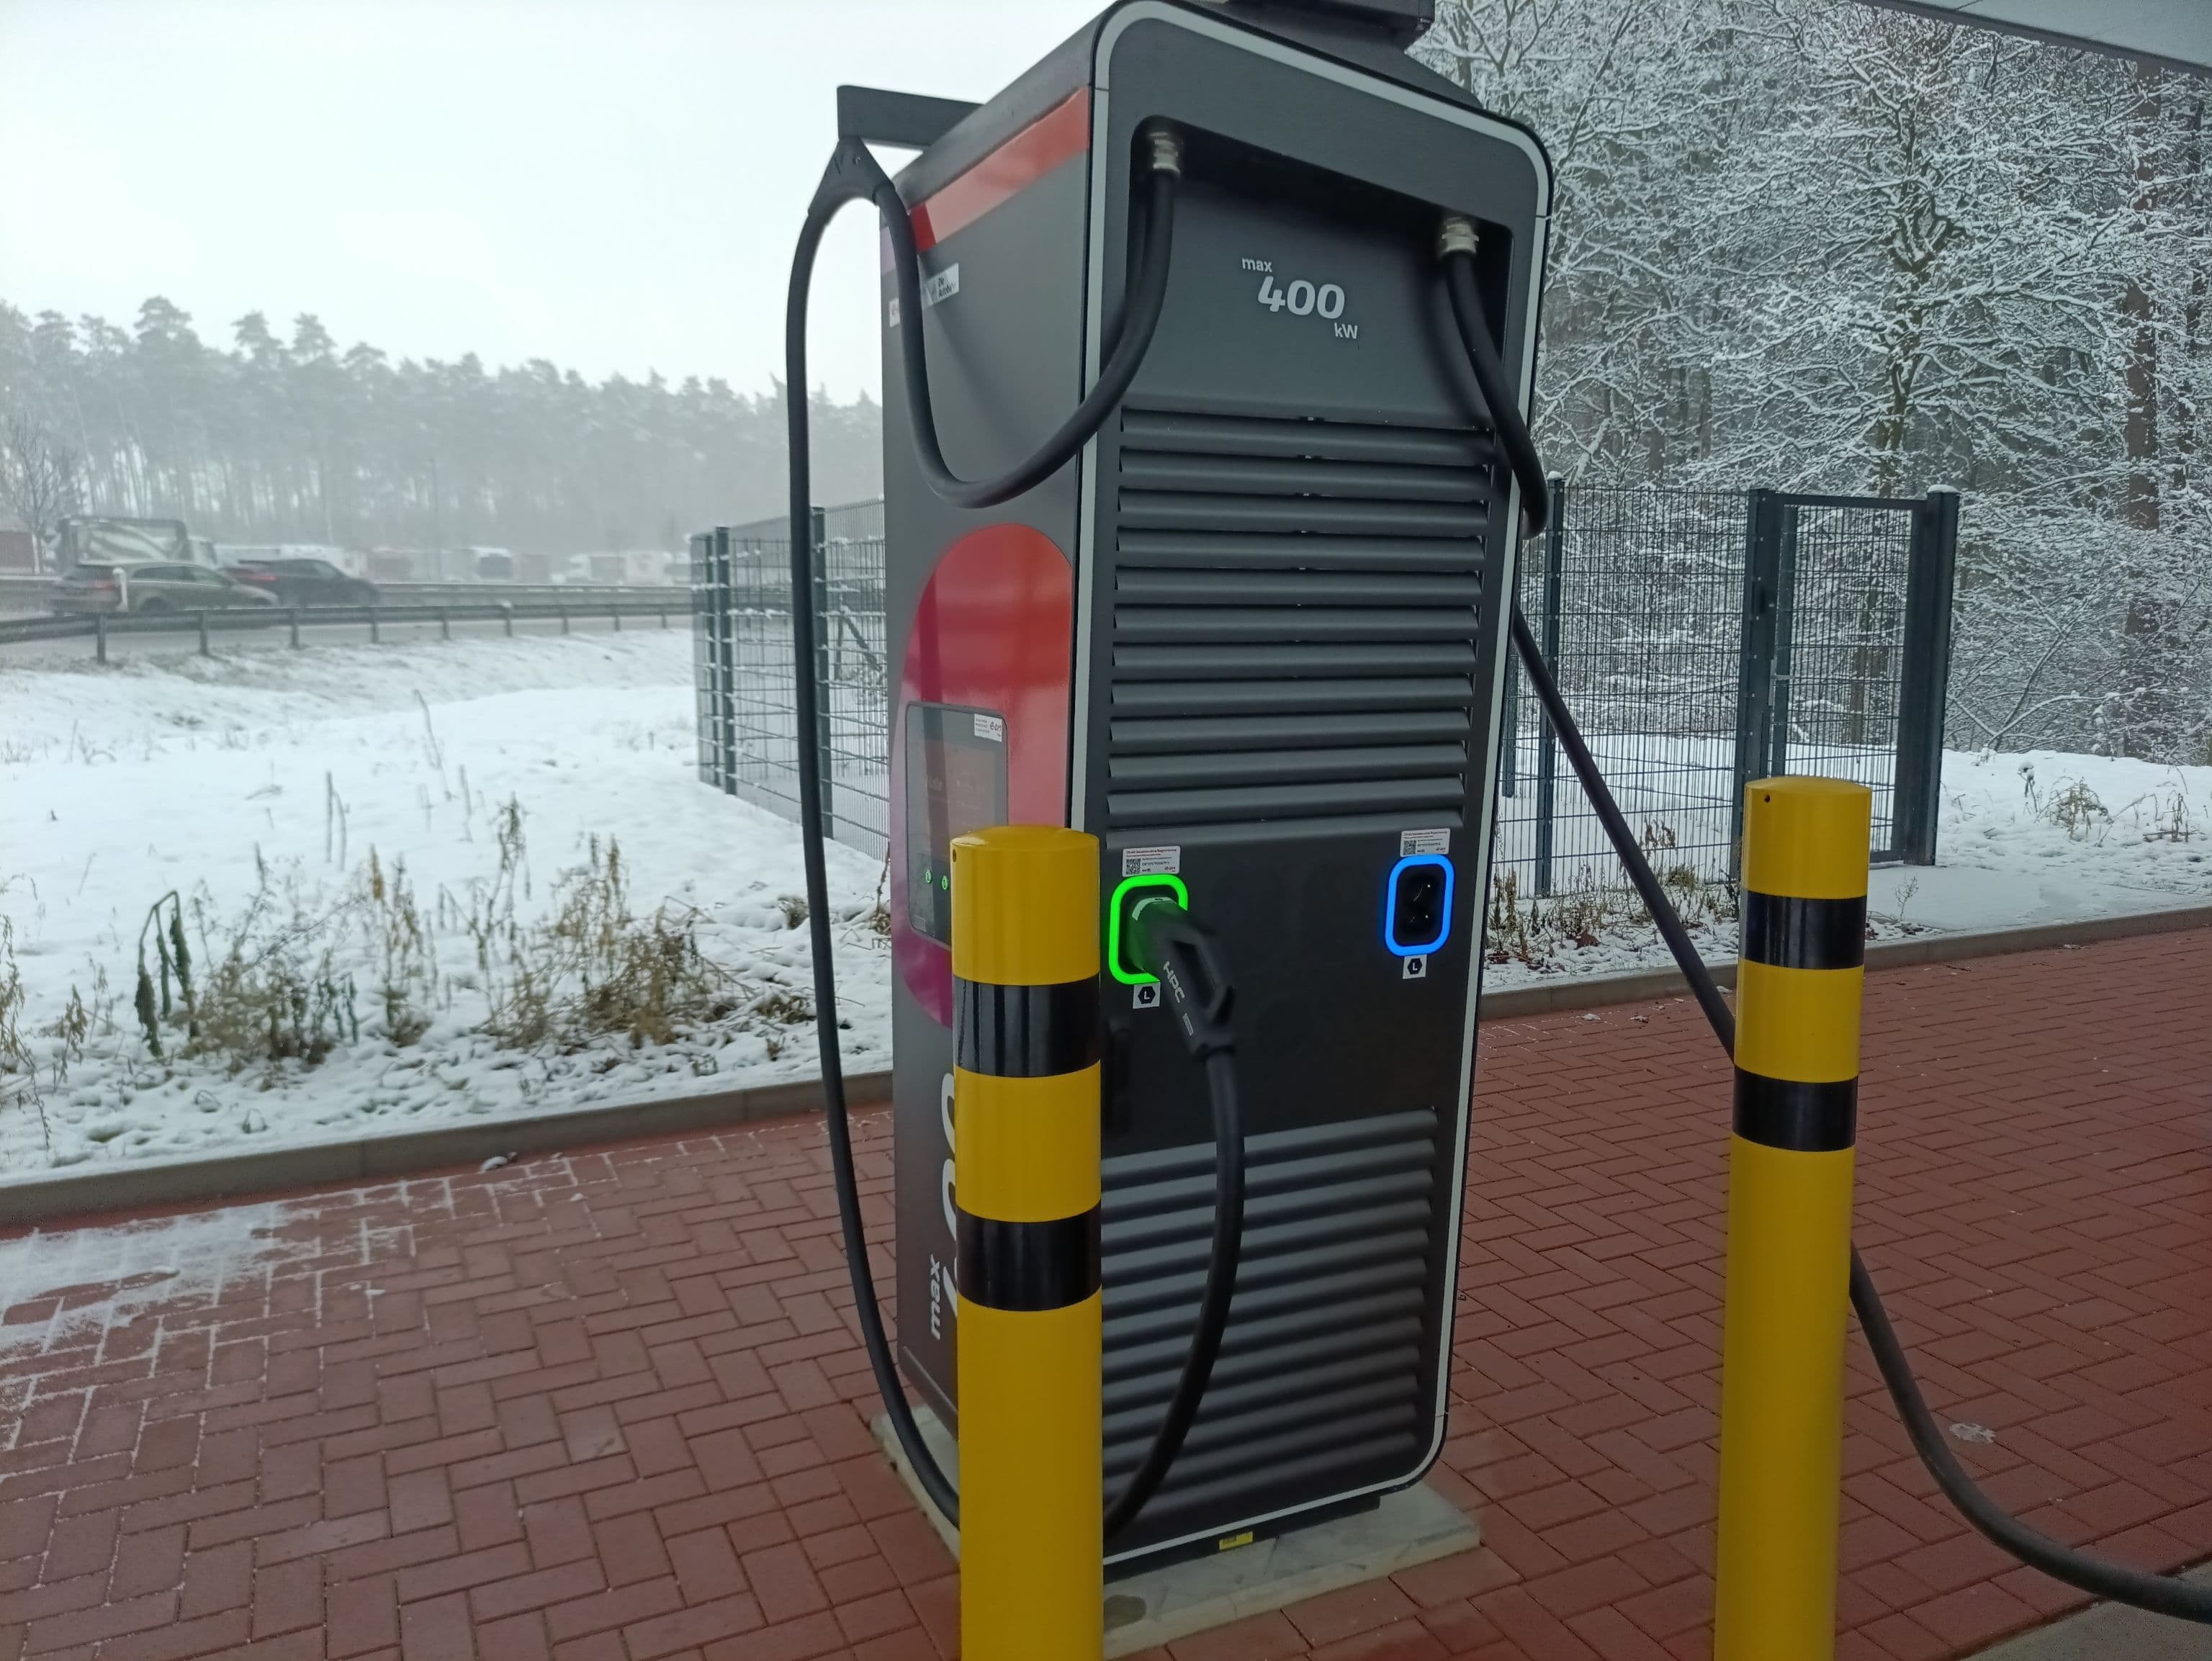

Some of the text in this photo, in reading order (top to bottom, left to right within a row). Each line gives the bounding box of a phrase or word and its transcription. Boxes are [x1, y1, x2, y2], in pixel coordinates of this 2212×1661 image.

[1241, 257, 1272, 273] max
[1258, 276, 1345, 319] 400
[1334, 322, 1358, 339] kW
[930, 1253, 940, 1341] max
